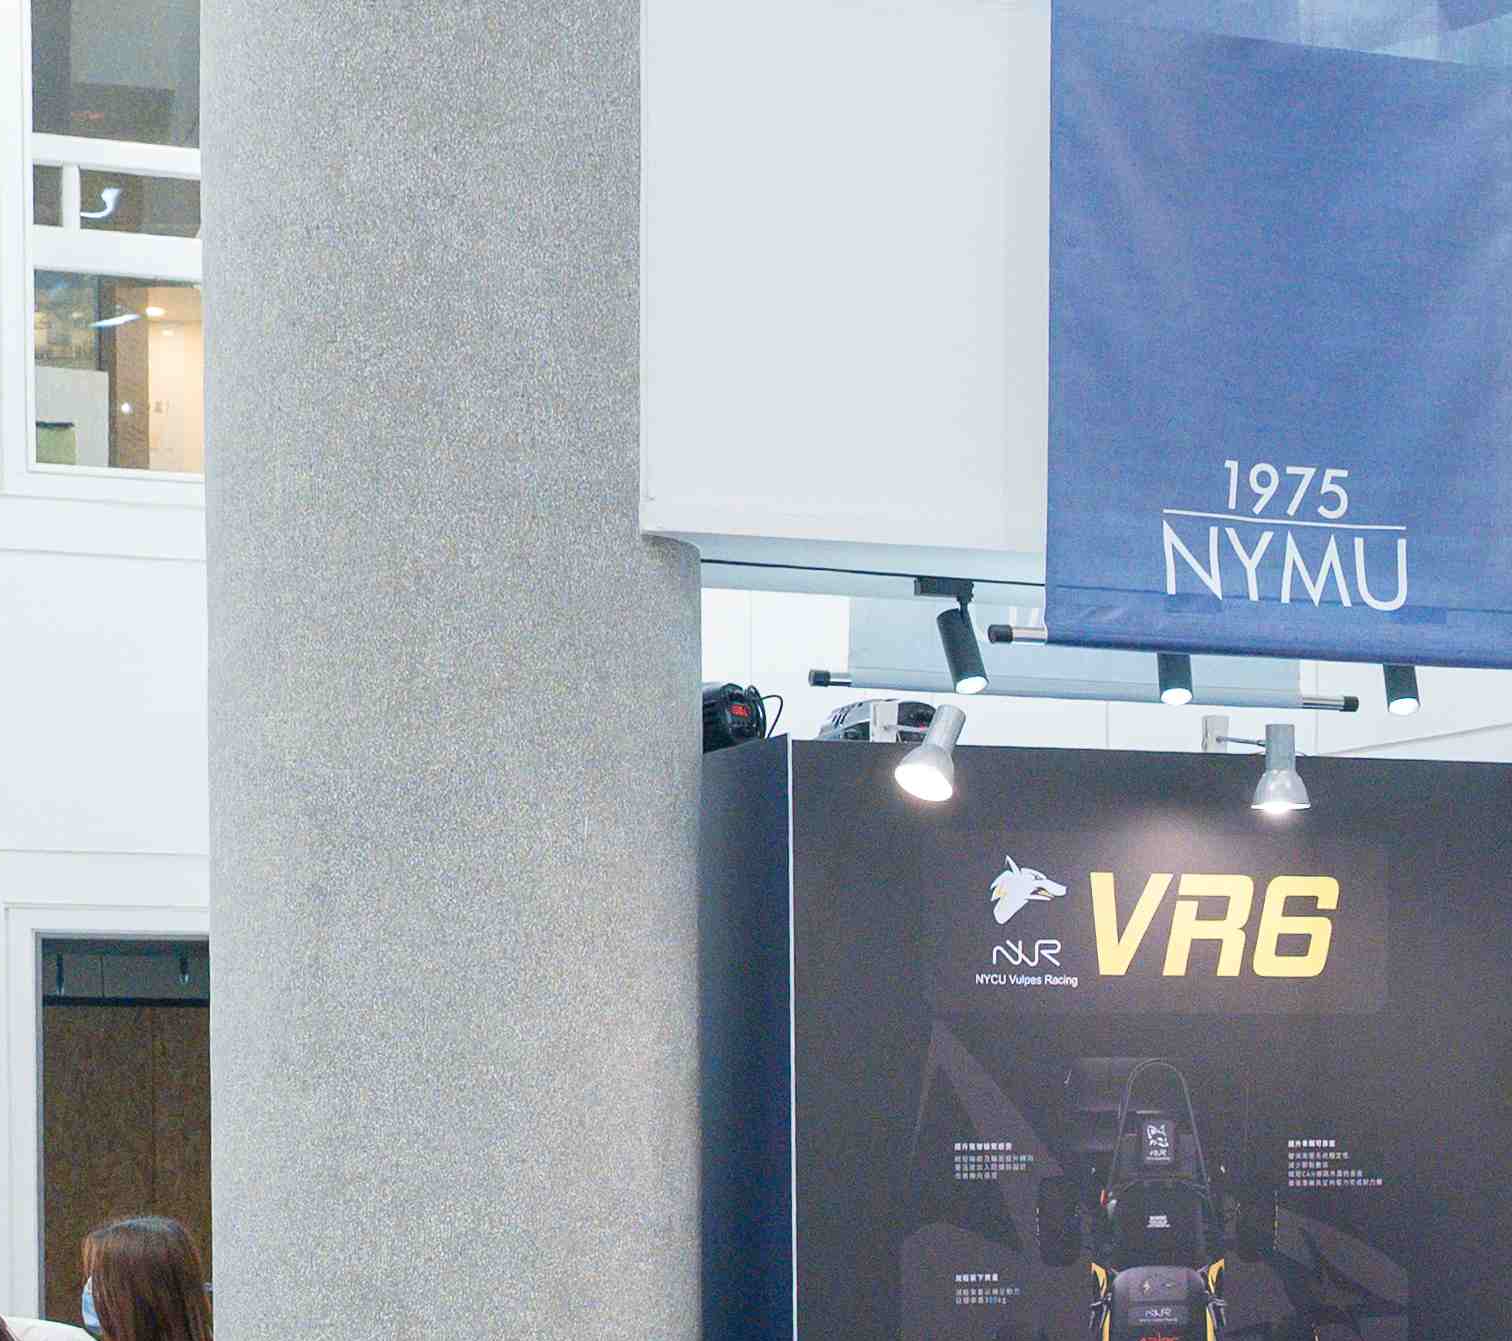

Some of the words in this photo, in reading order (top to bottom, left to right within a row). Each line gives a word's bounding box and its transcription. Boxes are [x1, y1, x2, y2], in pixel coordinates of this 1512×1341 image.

[1224, 460, 1349, 520] 1975
[1162, 519, 1408, 611] NYMU
[1090, 871, 1340, 978] VR6
[975, 974, 1007, 986] NYCU
[1009, 974, 1042, 987] Vulpes
[1044, 974, 1079, 989] Racing
